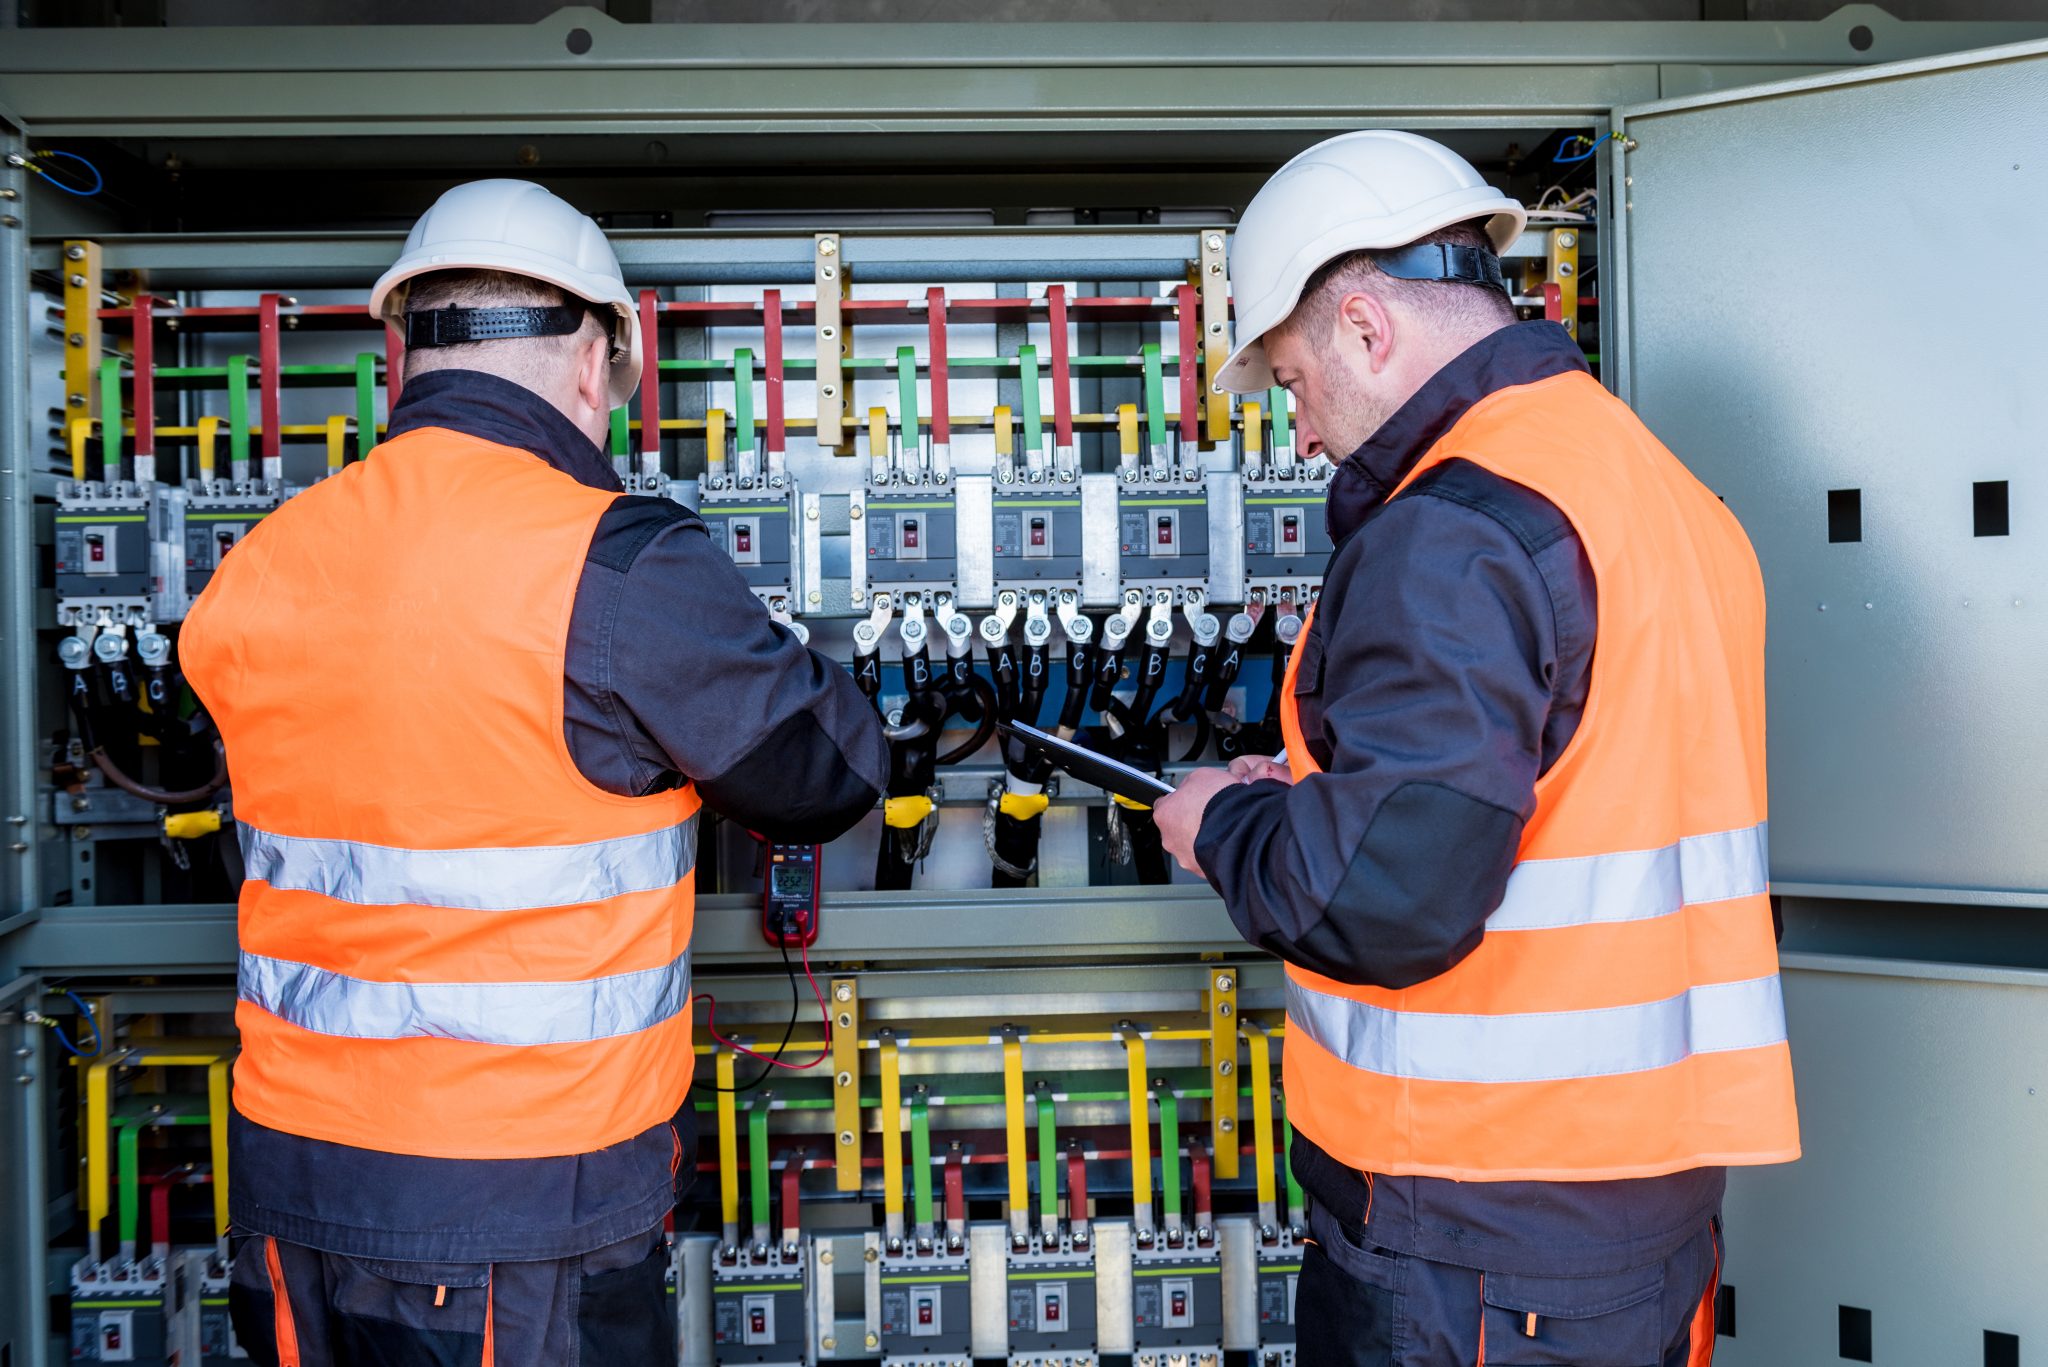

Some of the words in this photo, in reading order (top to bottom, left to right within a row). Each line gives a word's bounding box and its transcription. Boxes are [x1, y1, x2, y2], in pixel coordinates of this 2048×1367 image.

[857, 659, 878, 683] A
[914, 659, 928, 683] B
[954, 661, 968, 680] C
[997, 653, 1012, 672] A
[1029, 654, 1042, 676] B
[1073, 652, 1085, 670] C
[1102, 655, 1117, 674] A
[1148, 653, 1162, 675] B
[1193, 654, 1206, 673] C
[1223, 650, 1239, 671] A
[73, 674, 88, 696] A
[111, 670, 127, 694] B
[150, 679, 164, 700] C
[1223, 737, 1236, 752] C
